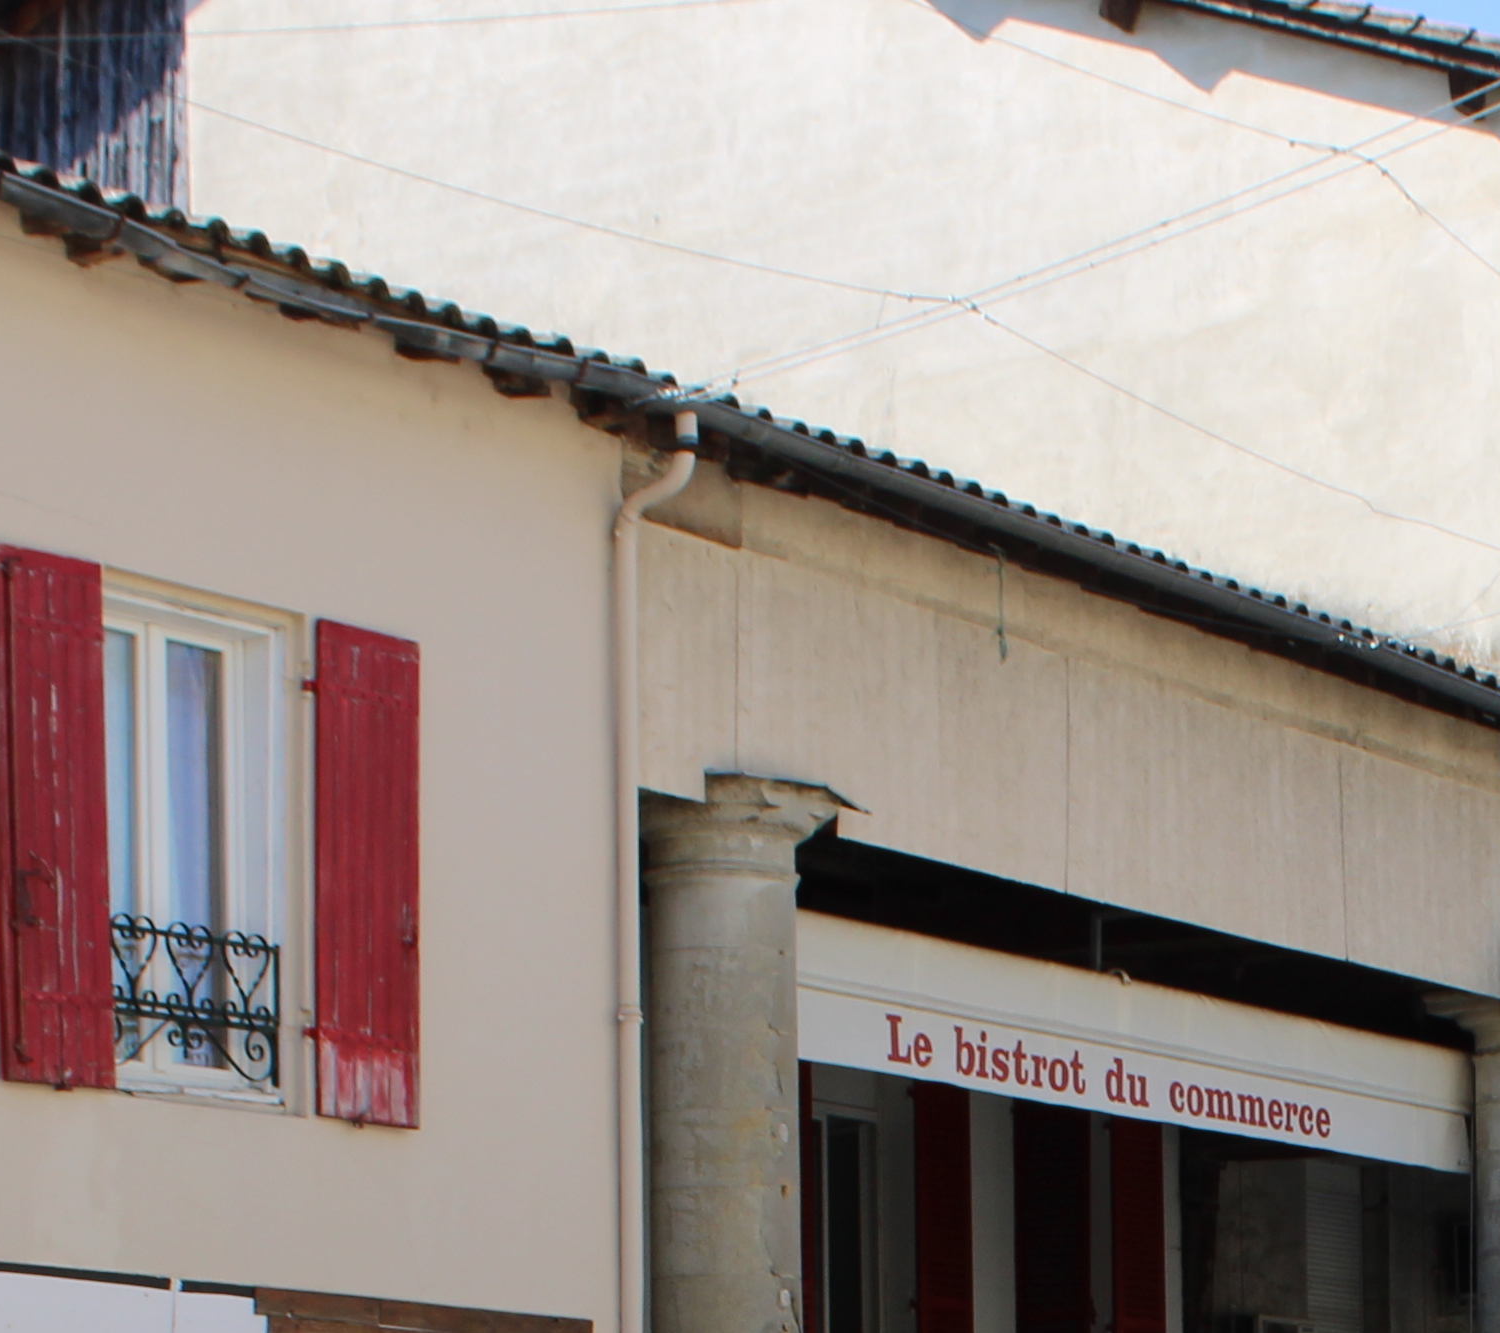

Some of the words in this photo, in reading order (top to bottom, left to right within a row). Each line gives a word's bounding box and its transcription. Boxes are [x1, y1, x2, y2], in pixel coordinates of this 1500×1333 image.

[886, 1013, 933, 1068] Le
[954, 1025, 1086, 1095] bistrot
[1105, 1057, 1150, 1108] du
[1169, 1081, 1331, 1138] commerce
